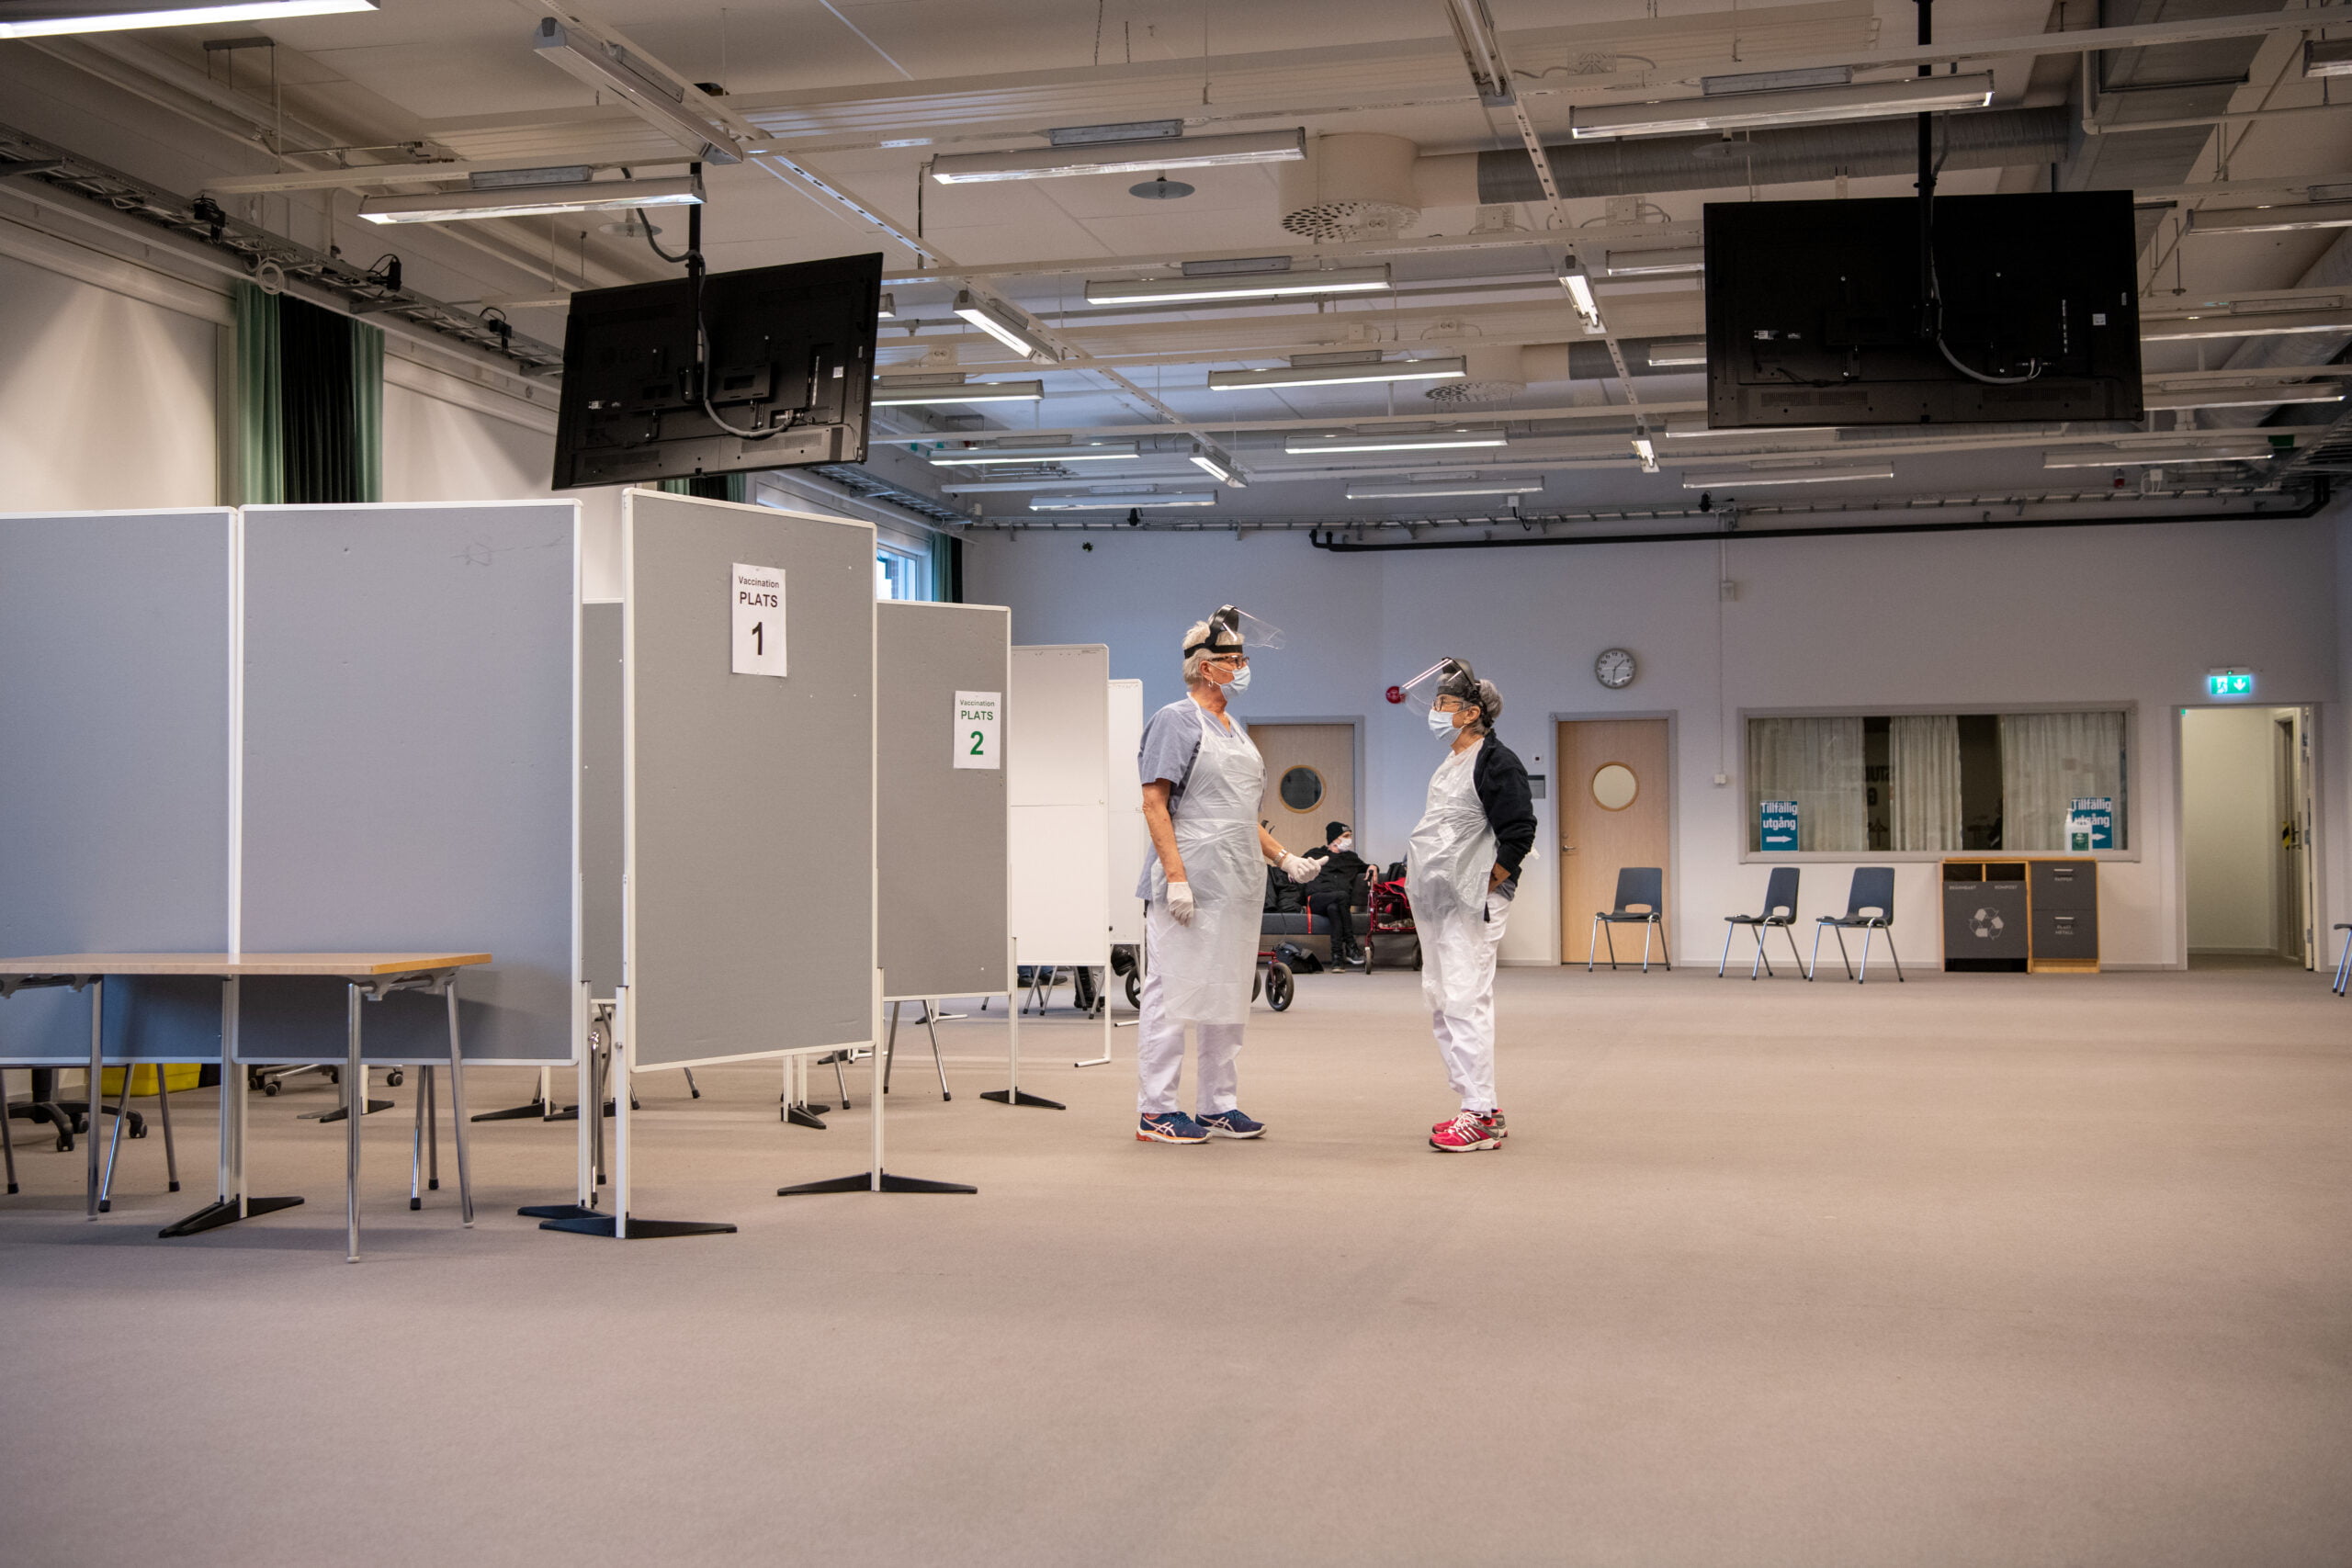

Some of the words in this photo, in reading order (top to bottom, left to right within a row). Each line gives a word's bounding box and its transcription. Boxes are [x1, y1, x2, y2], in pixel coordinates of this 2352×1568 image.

[739, 576, 779, 588] Vaccination
[740, 592, 778, 607] PLATS
[752, 621, 763, 656] 1
[961, 710, 993, 720] PLATS
[970, 730, 984, 755] 2
[1760, 801, 1797, 815] Tillfällig
[2072, 798, 2111, 813] Tillfällig
[1762, 816, 1796, 830] utgång
